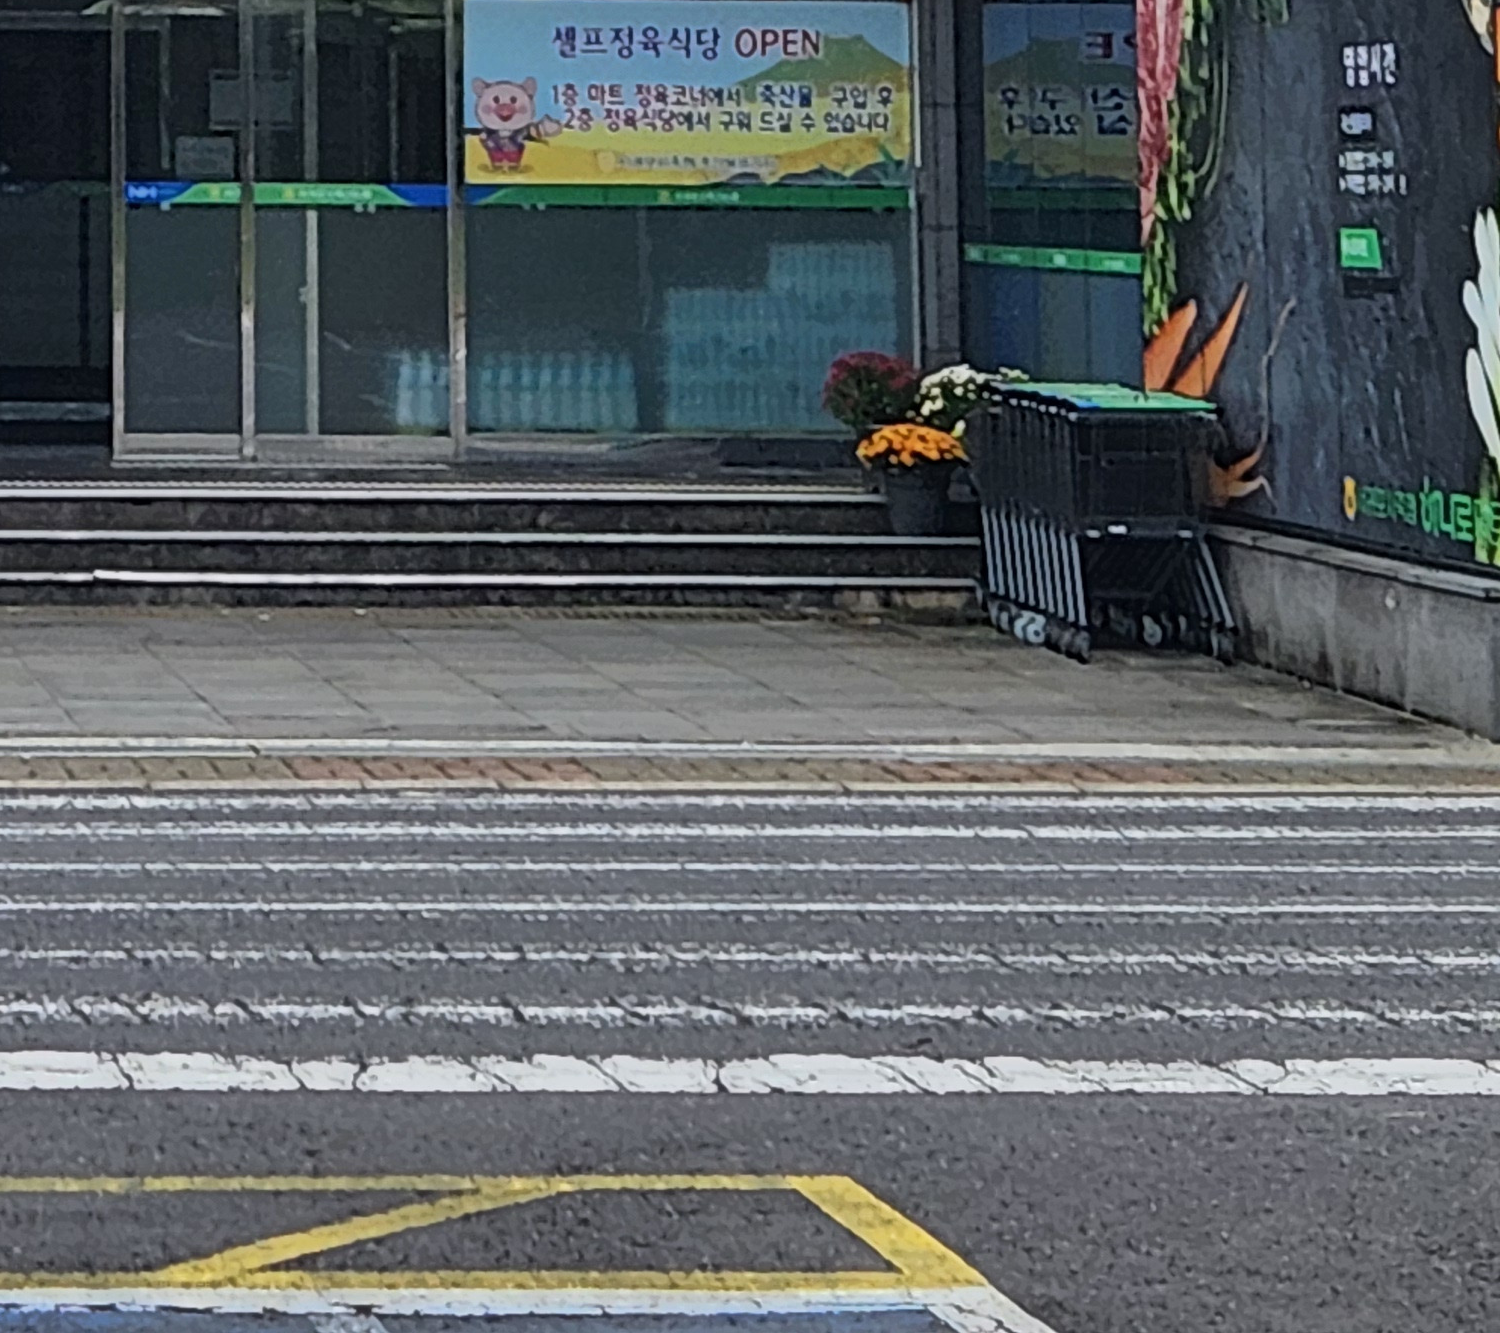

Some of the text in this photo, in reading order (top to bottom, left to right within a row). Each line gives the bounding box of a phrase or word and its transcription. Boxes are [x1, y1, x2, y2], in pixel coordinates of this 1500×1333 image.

[552, 25, 821, 61] 셀프정육식당 OPEN
[552, 82, 894, 110] 1층 마트 정육코너에서 축산물 구입 후
[563, 107, 594, 132] 2층
[603, 107, 711, 133] 정육식당에서
[758, 110, 793, 133] 드실
[800, 111, 817, 133] 수
[822, 110, 891, 134] 있습니다
